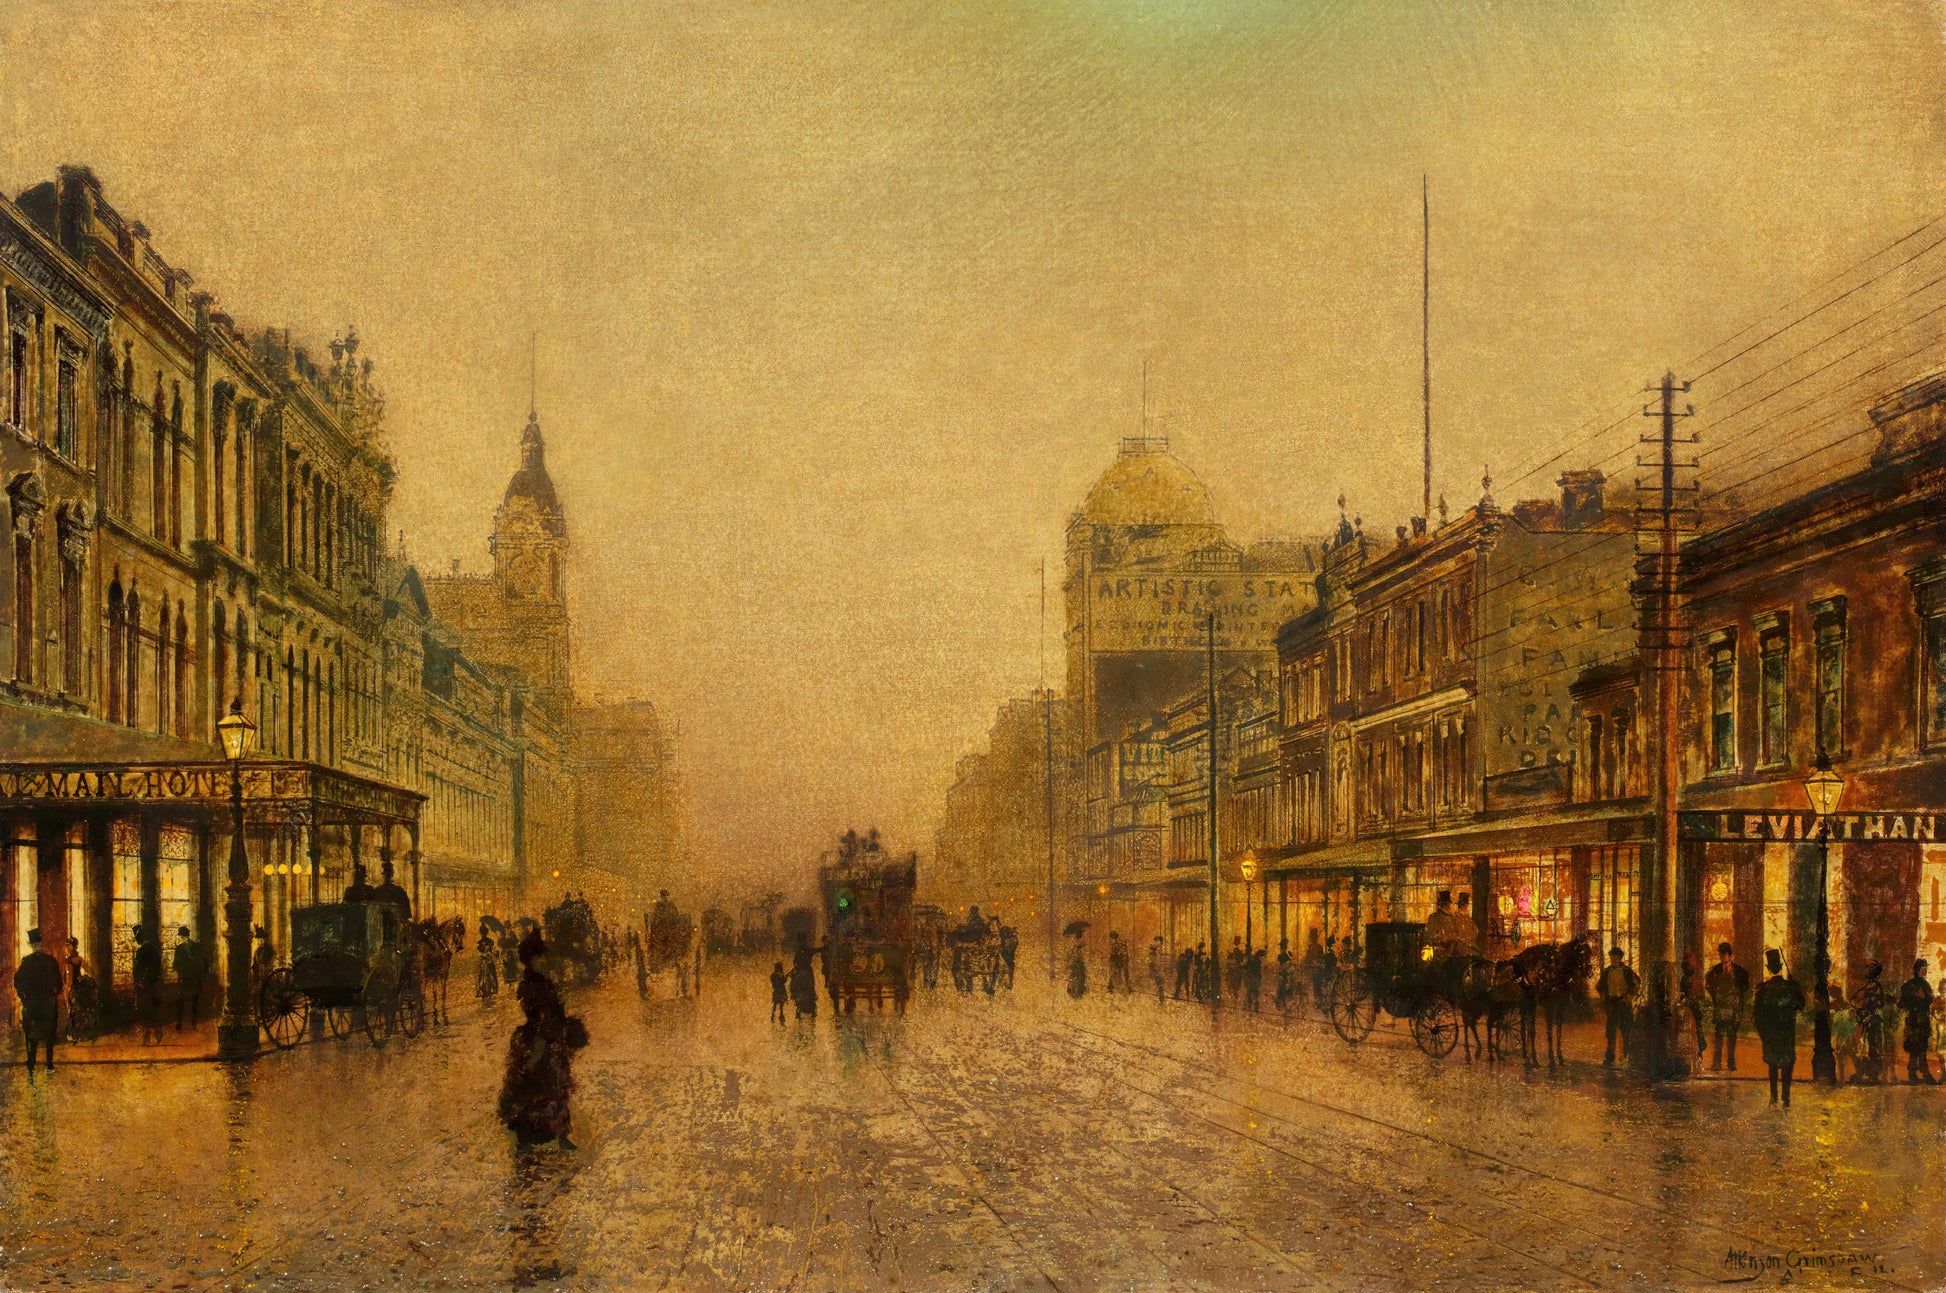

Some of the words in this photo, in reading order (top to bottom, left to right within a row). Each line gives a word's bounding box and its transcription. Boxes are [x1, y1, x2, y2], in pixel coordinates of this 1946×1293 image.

[1098, 578, 1220, 598] ARTISTIC
[144, 770, 243, 797] HOTE
[1718, 814, 1936, 840] LEVIATHAN
